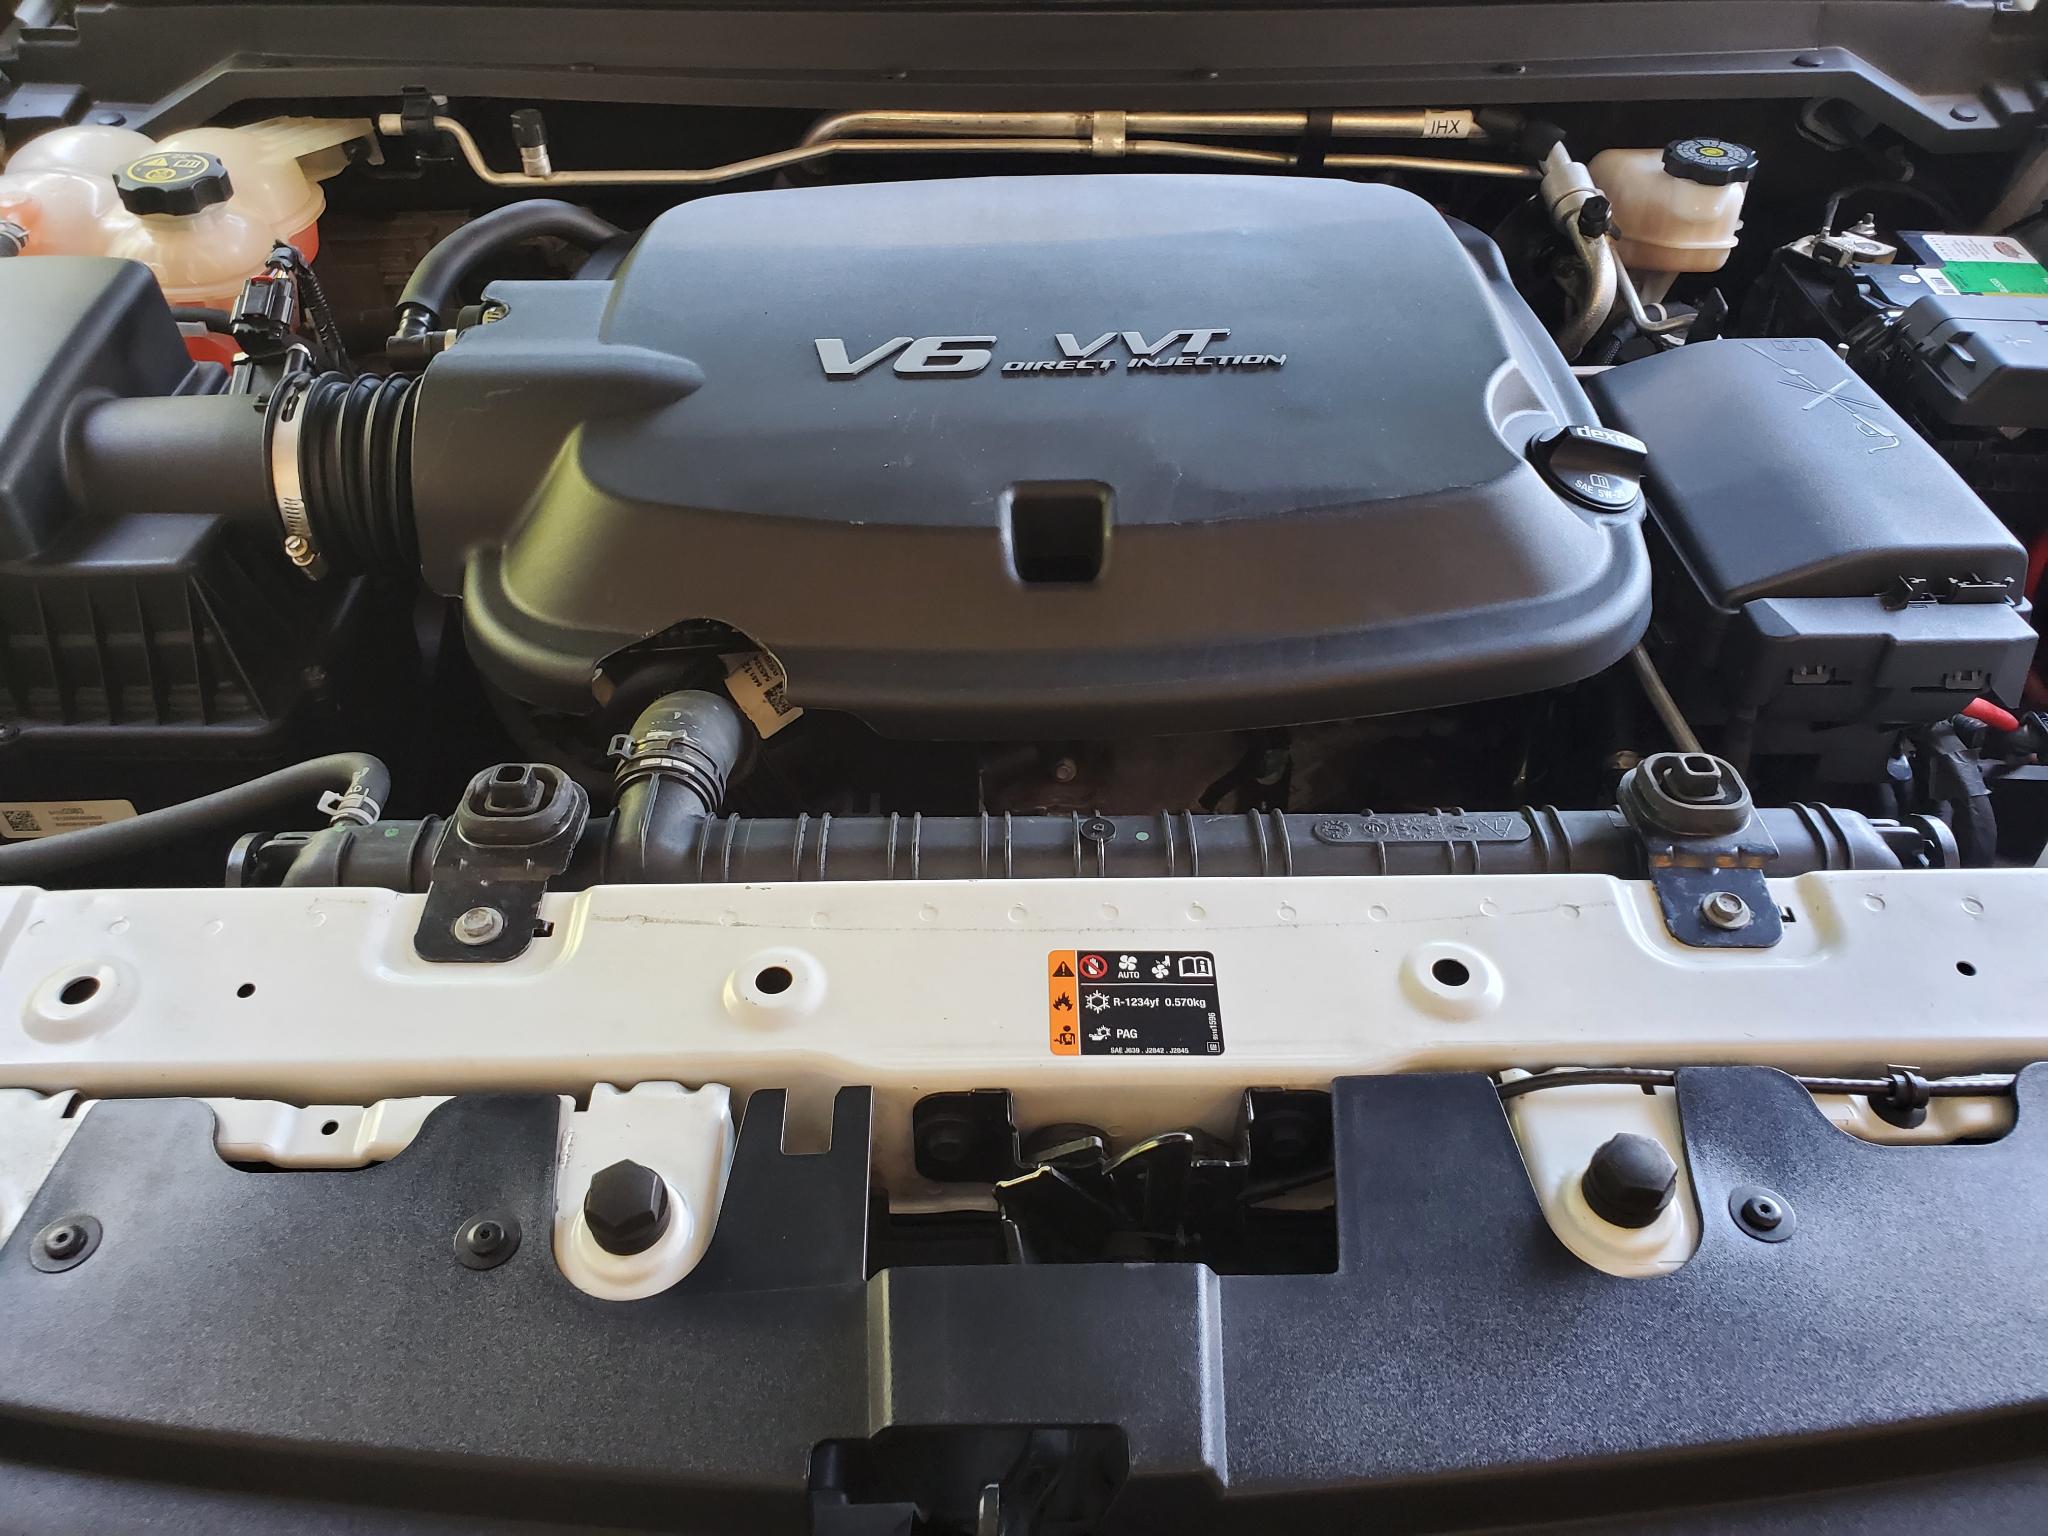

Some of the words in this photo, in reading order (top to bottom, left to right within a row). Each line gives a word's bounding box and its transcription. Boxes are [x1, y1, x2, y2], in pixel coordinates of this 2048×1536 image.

[1431, 120, 1460, 134] IHX
[815, 336, 998, 374] V6
[1055, 328, 1231, 358] VVT
[1002, 357, 1116, 372] DIRECT
[1126, 354, 1287, 369] INJECTION
[1574, 479, 1594, 494] SAE
[1117, 971, 1140, 979] AUTO
[1113, 997, 1160, 1009] R-1234yf
[1164, 997, 1207, 1009] 0.570kg
[1116, 1028, 1138, 1039] PAG
